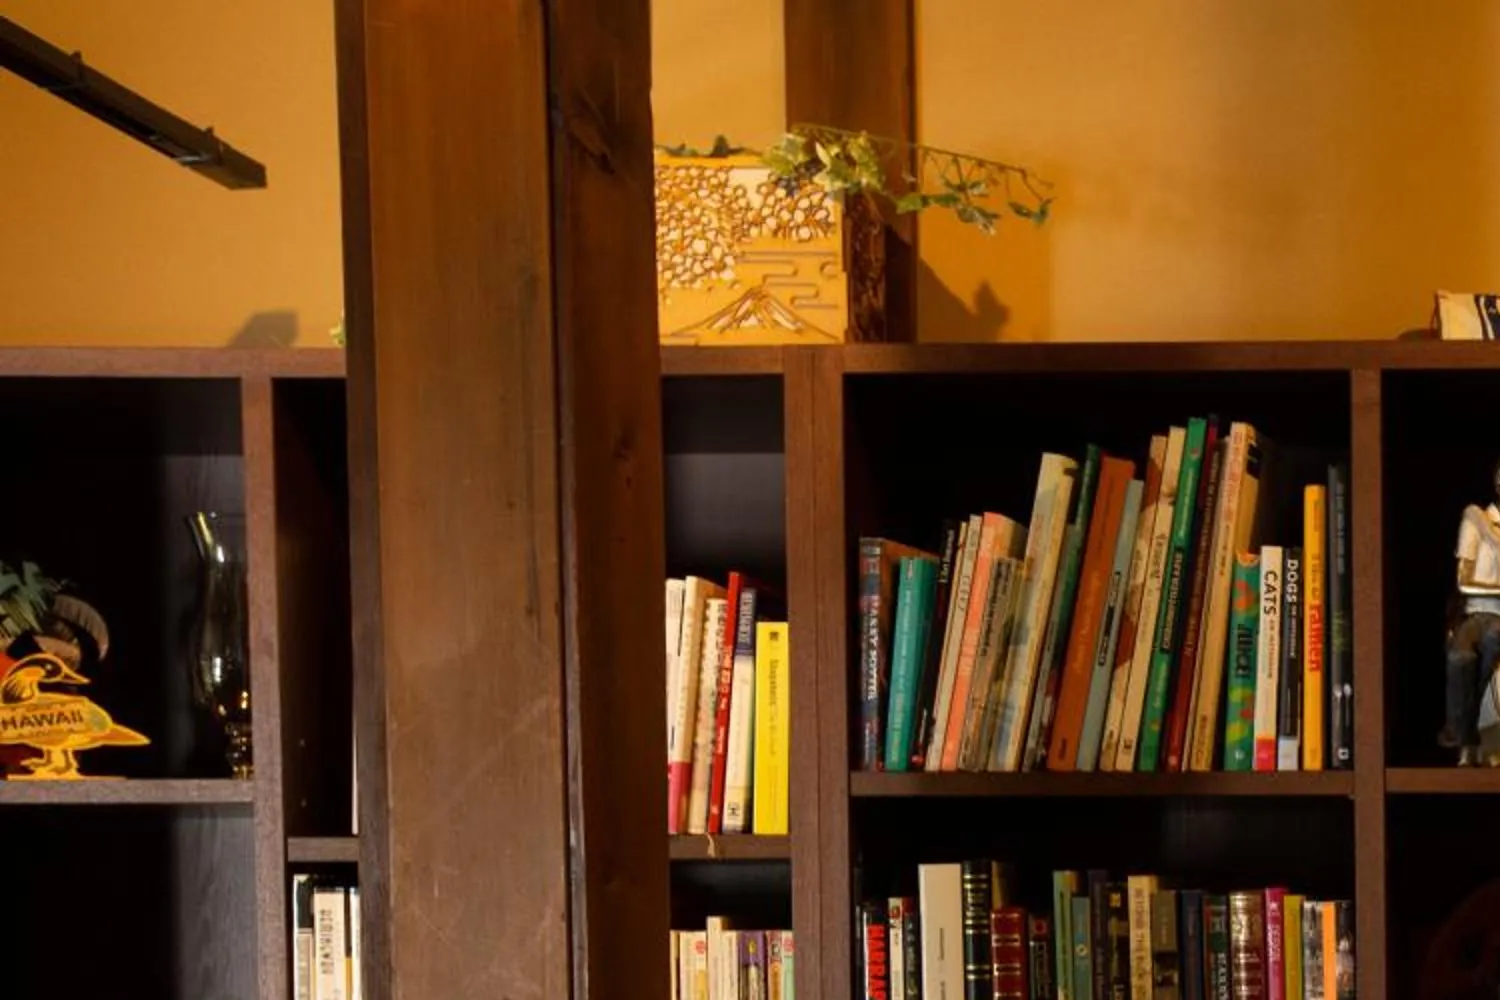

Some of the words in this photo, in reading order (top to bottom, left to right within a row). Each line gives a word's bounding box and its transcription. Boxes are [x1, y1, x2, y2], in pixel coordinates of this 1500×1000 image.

[1264, 571, 1277, 615] CATS
[1286, 559, 1299, 602] DOGS
[1, 710, 84, 730] HAWAII
